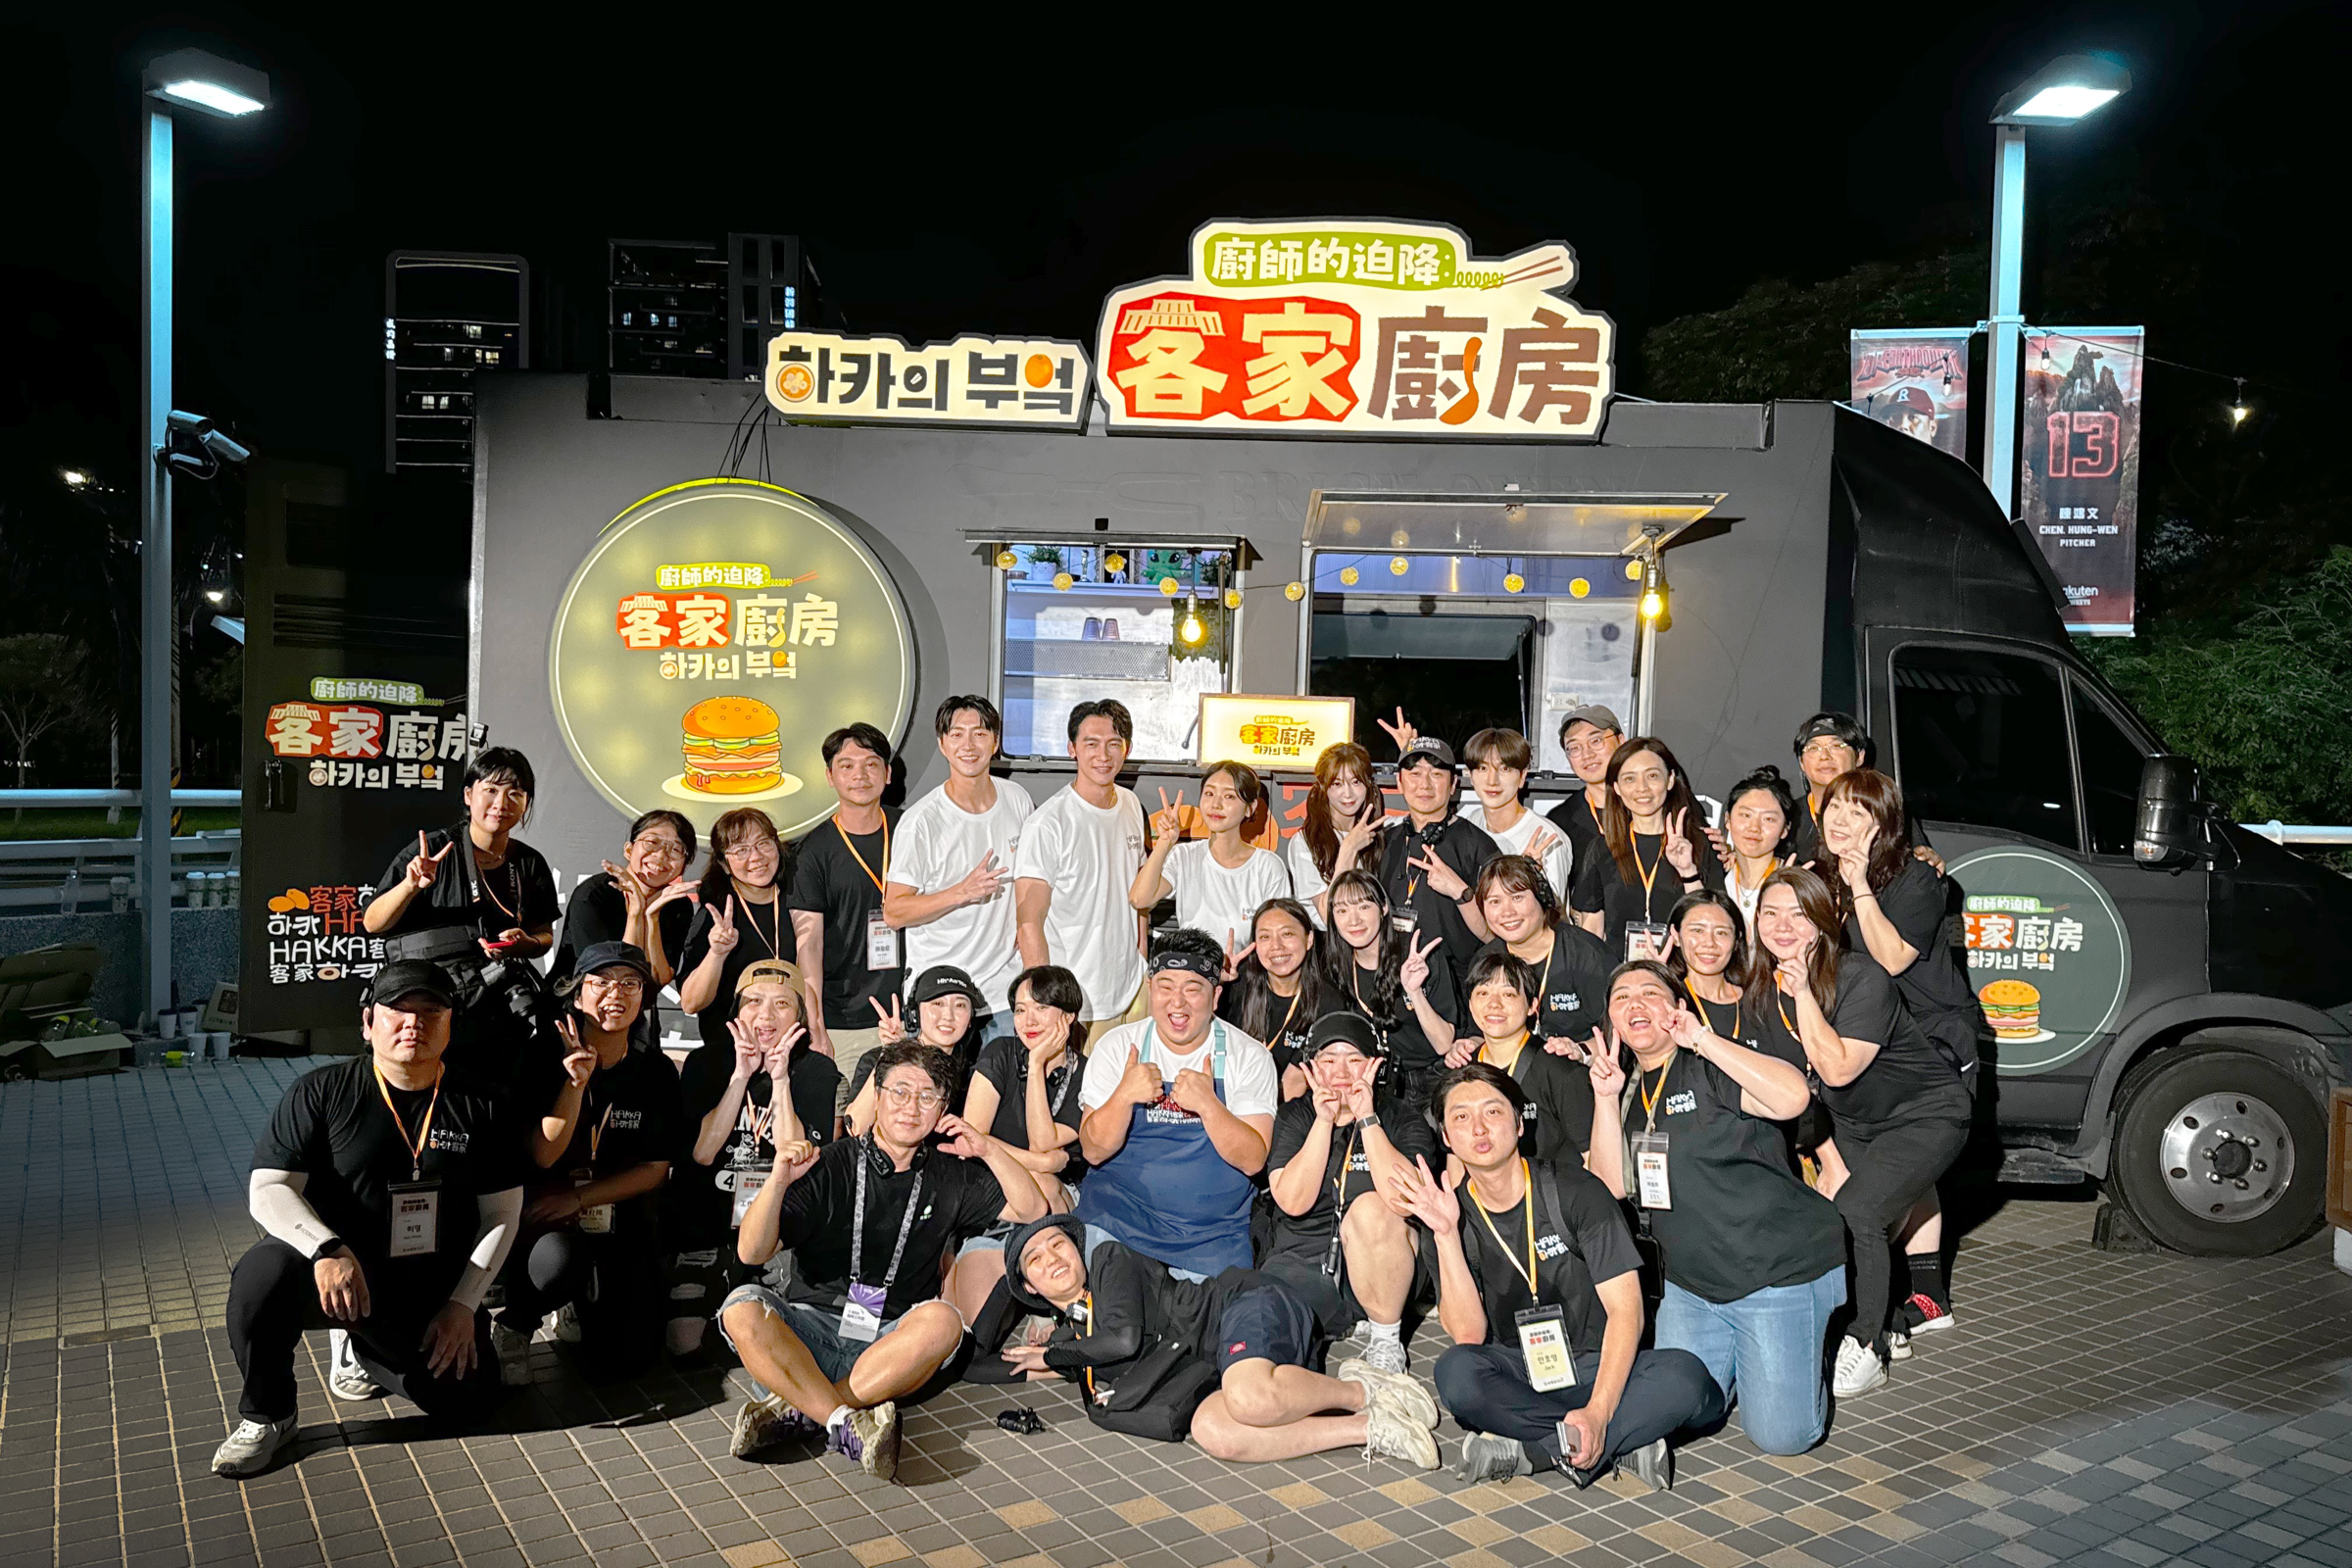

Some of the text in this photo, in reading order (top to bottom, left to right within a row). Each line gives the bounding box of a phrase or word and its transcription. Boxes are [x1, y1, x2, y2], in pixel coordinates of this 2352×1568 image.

[1115, 300, 1603, 426] 客家廚房
[778, 345, 951, 413] 하카의
[2047, 411, 2120, 477] 13
[2060, 538, 2096, 547] PITCHER
[2068, 525, 2119, 535] HUNG-WEN
[619, 592, 839, 648] 客家廚房
[660, 652, 740, 680] 하카의
[1241, 725, 1315, 746] 客家廚房
[309, 760, 389, 790] 하카의
[1967, 950, 2019, 970] 하카의
[430, 1128, 469, 1145] HAKKA
